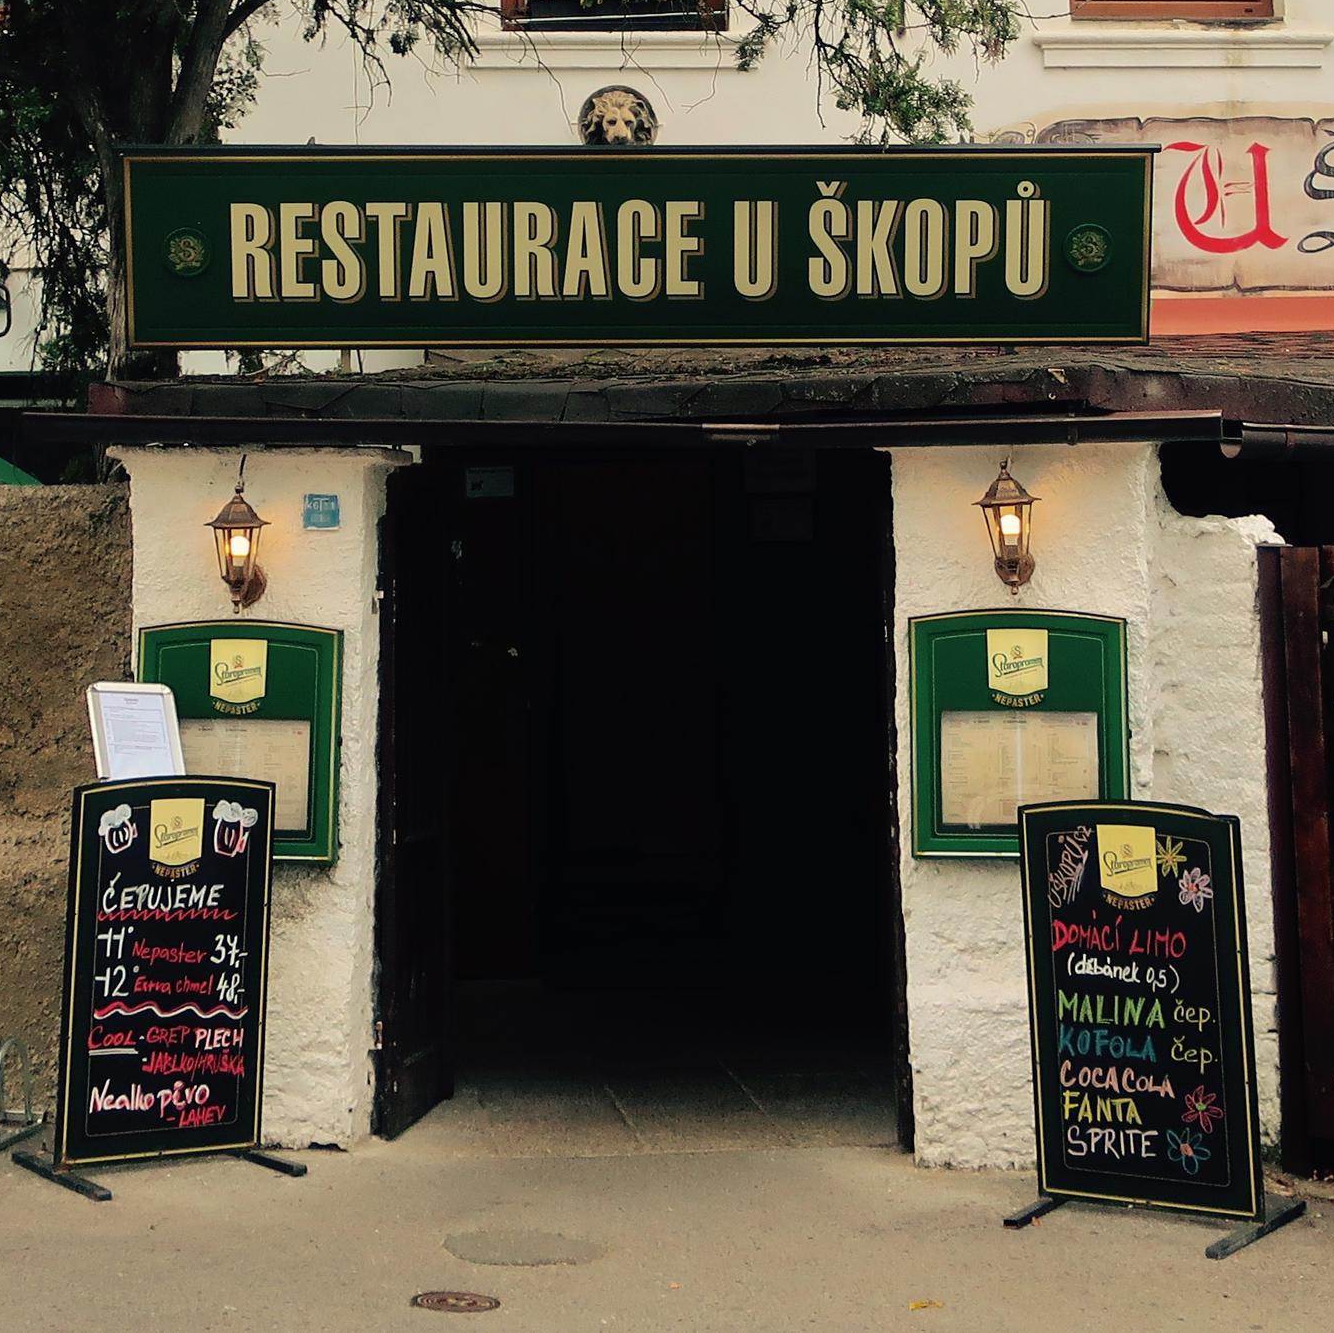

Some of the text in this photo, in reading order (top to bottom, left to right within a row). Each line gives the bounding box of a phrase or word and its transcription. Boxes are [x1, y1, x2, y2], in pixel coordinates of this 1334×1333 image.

[1163, 141, 1289, 254] U
[230, 180, 1050, 301] RESTAURACE U ŠKOPŮ
[213, 701, 259, 715] NEPASTER
[994, 693, 1042, 707] NEPASTER
[153, 864, 198, 879] NEPASTER
[102, 872, 225, 914] ČEPUJEME
[1105, 893, 1153, 911] NEPASTER
[131, 938, 208, 966] Nepaster
[1128, 927, 1187, 959] LIMO
[175, 974, 215, 996] chmel
[1058, 989, 1166, 1030] MALINA
[194, 1027, 245, 1051] PLECH
[1058, 1023, 1157, 1063] KOFOLA
[178, 1104, 227, 1129] LAHEV
[1062, 1089, 1143, 1126] FANTA
[1067, 1125, 1159, 1160] SPRITE
